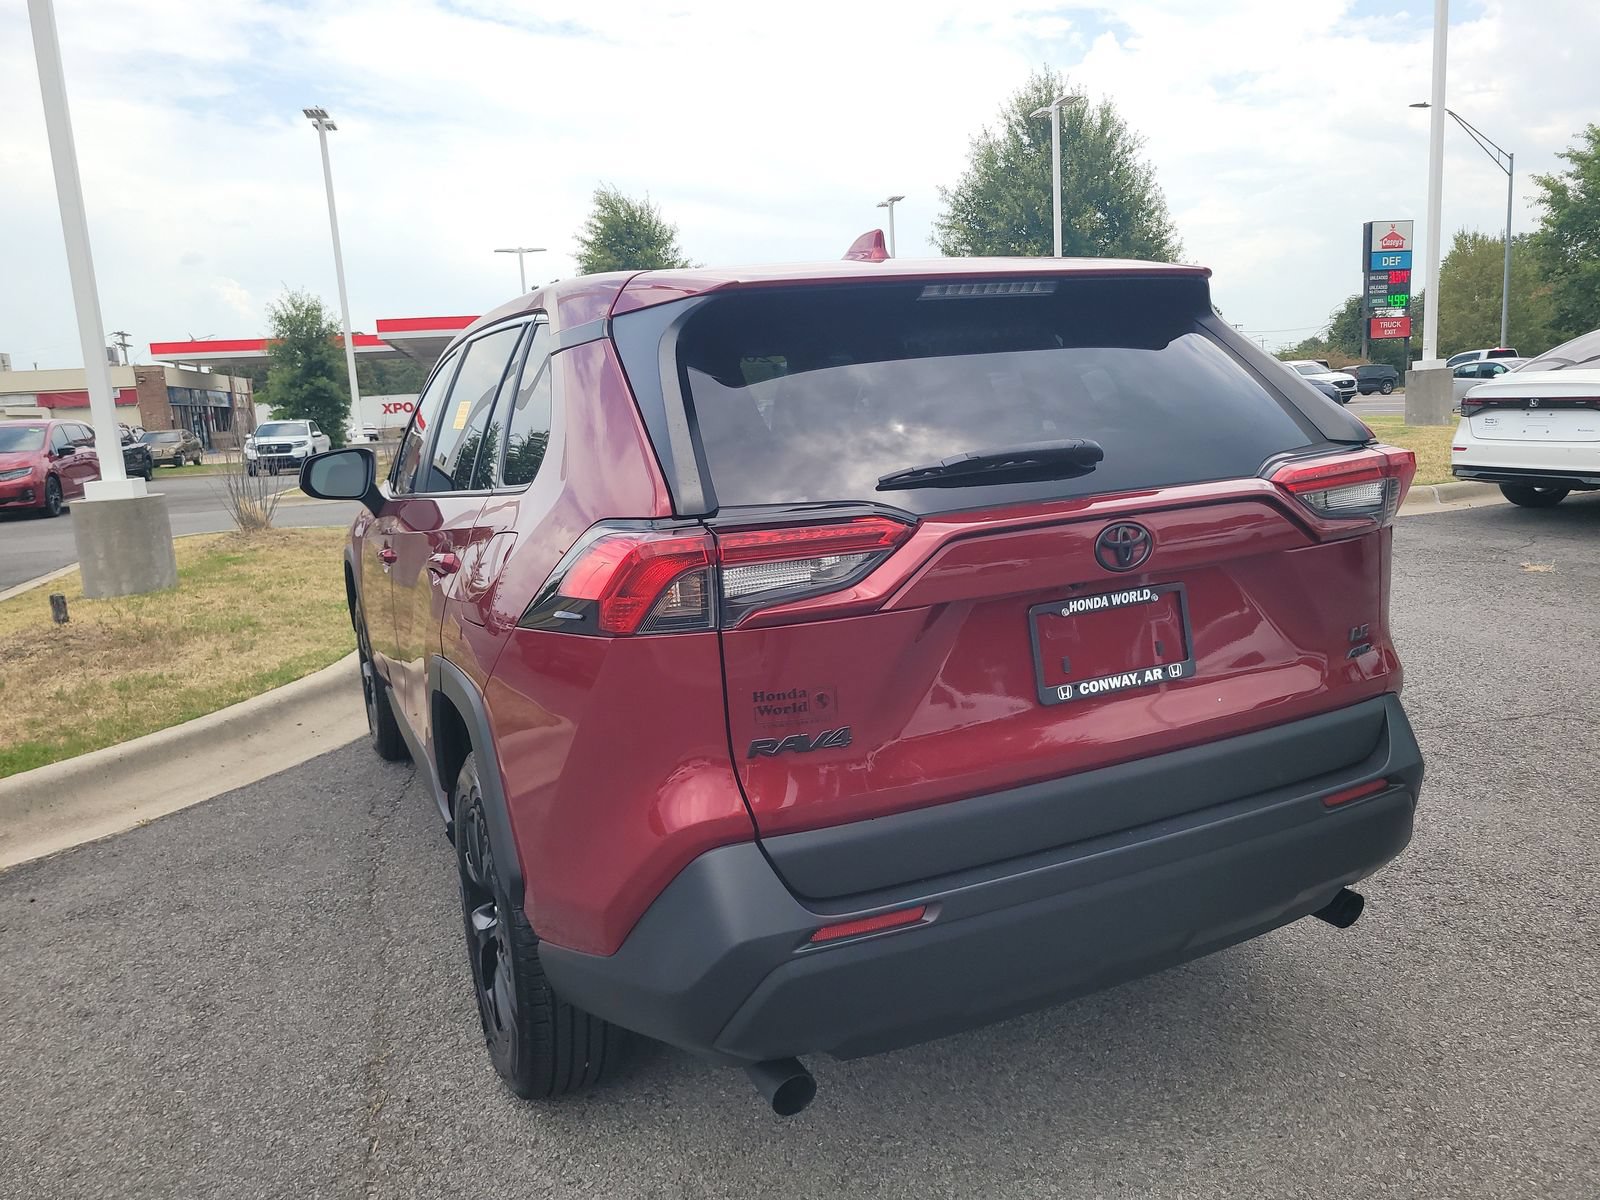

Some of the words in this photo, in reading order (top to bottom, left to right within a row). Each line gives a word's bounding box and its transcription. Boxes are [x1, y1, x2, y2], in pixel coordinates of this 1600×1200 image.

[1382, 256, 1402, 266] DEF
[382, 402, 415, 415] XPO
[1069, 595, 1109, 613] HONDA
[1111, 589, 1151, 606] WORLD
[1079, 672, 1142, 695] CONWAY,
[1144, 668, 1163, 681] AR
[752, 688, 807, 702] Honda
[757, 702, 808, 716] World
[747, 726, 852, 759] RAV4
